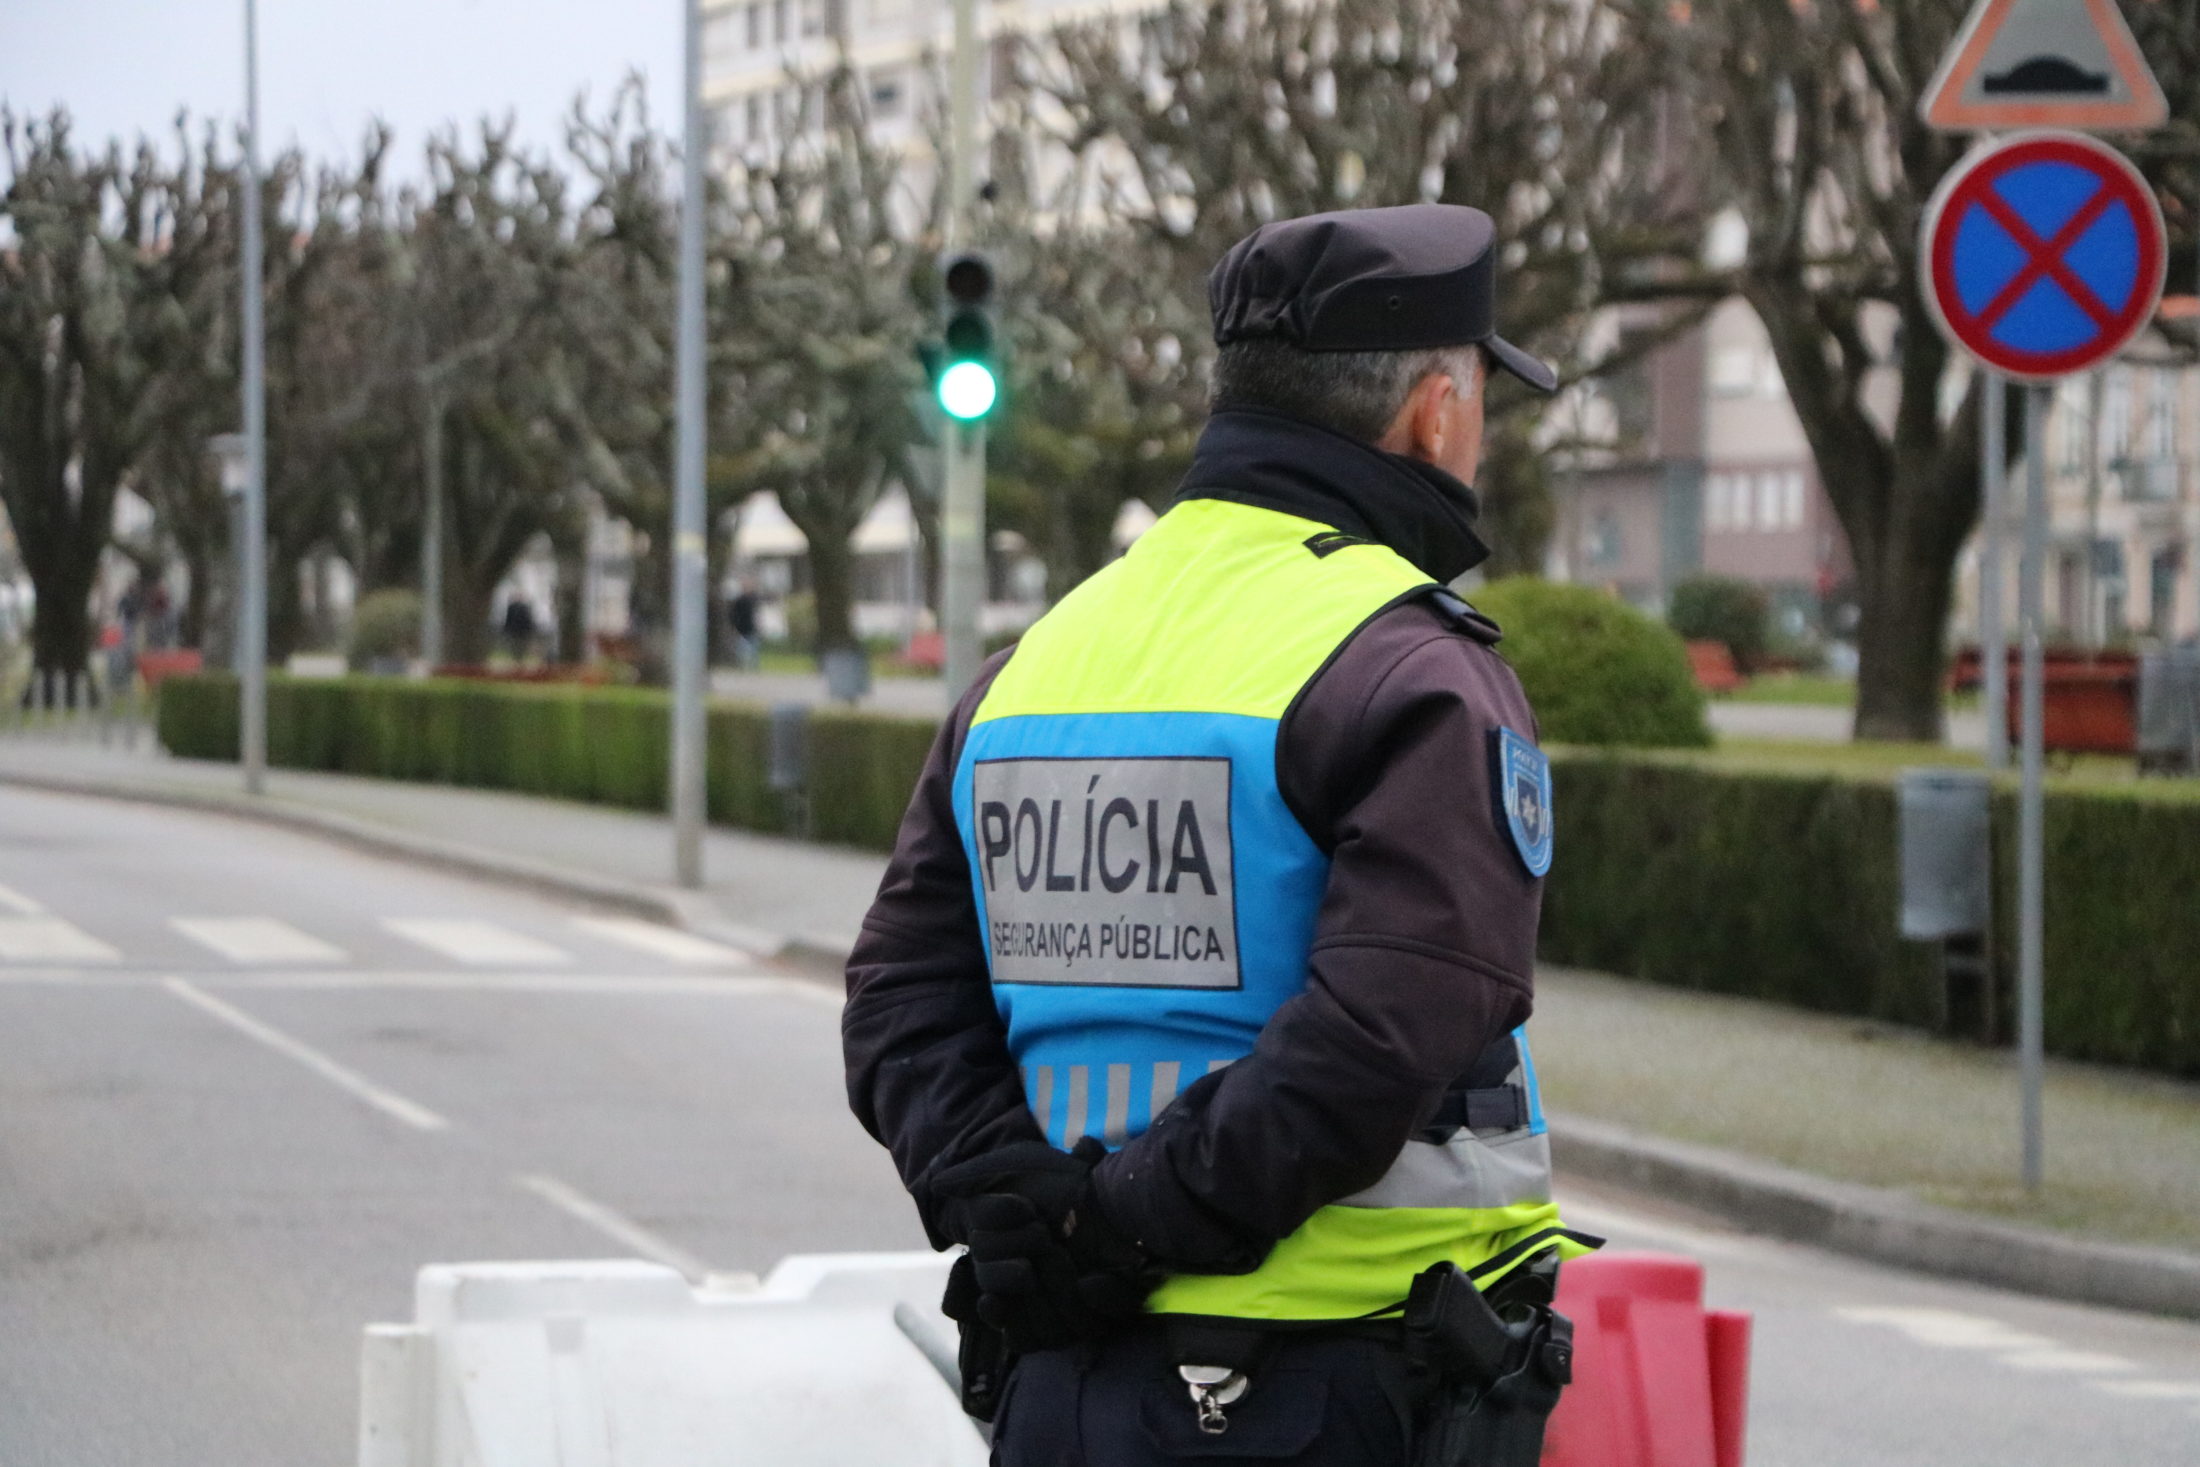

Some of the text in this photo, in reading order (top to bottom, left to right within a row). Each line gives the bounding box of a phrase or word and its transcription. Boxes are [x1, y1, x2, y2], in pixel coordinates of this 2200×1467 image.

[981, 774, 1218, 896] POLÍCIA
[994, 915, 1225, 967] SEGURANÇA PÚBLICA
